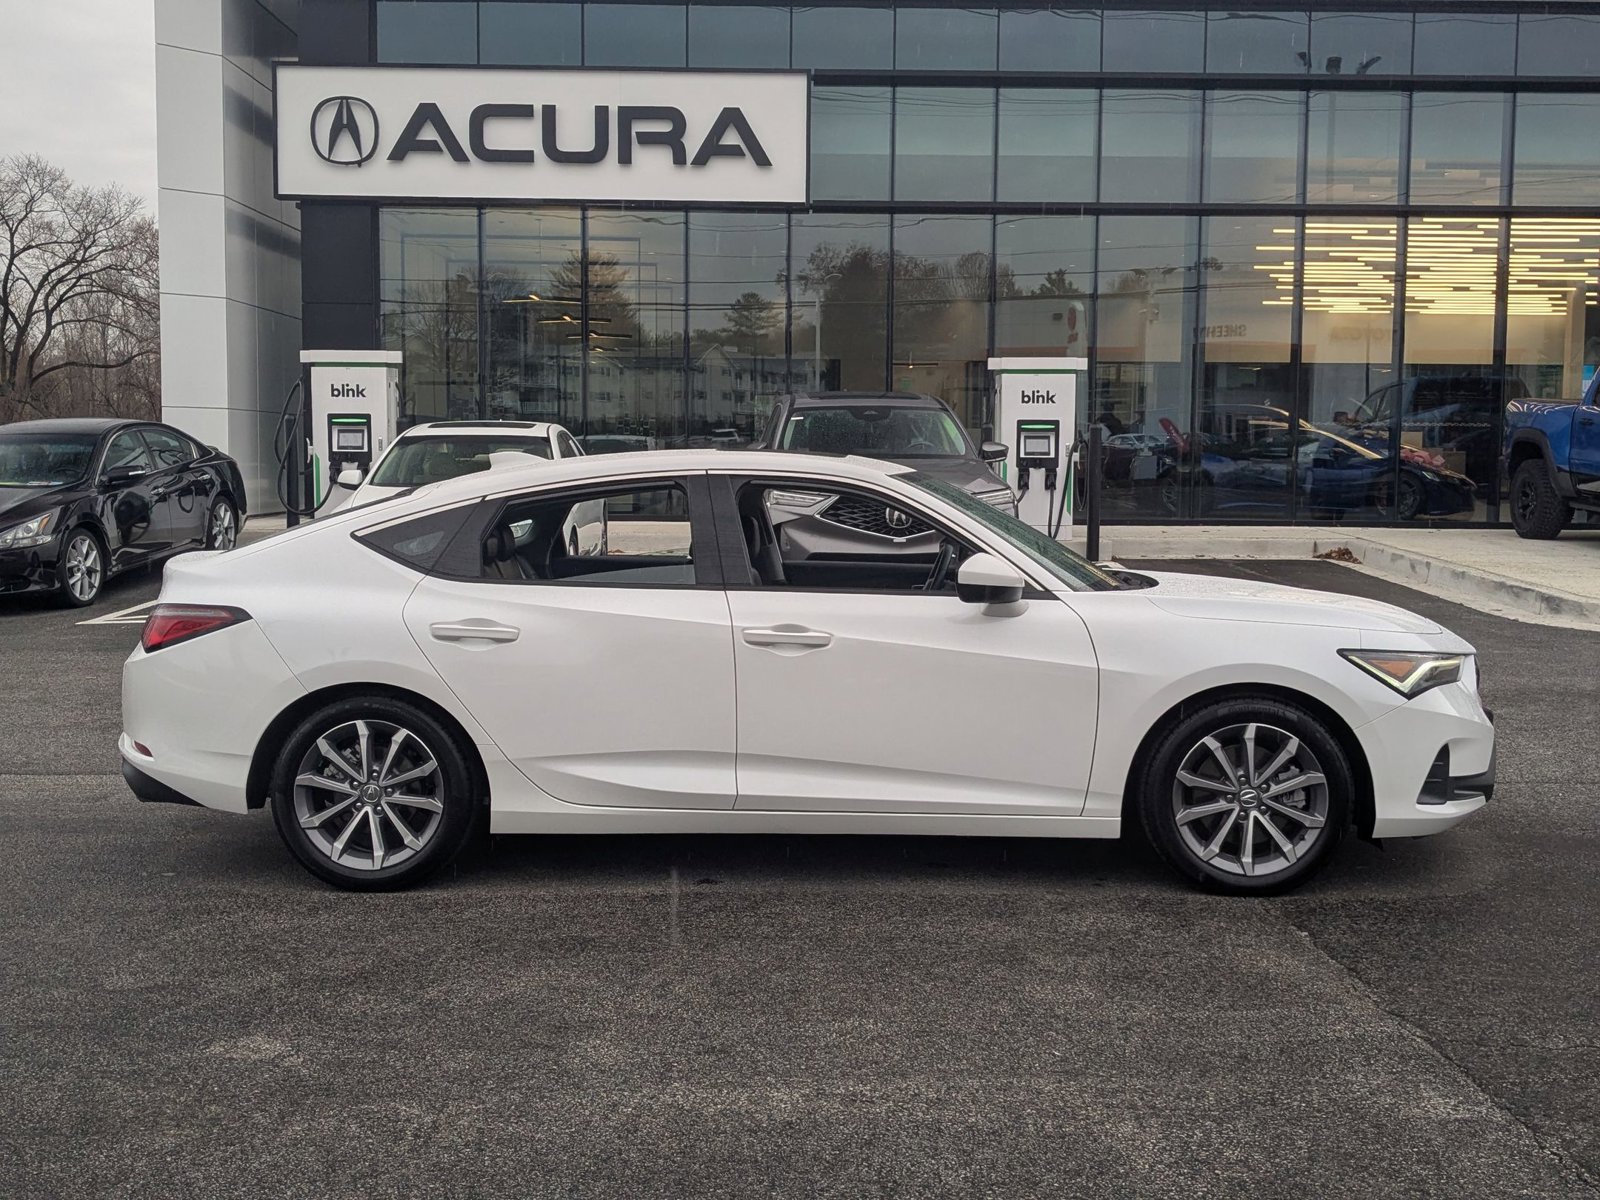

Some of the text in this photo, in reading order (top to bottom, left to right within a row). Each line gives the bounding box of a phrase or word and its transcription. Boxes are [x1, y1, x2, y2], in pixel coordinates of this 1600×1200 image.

[386, 102, 773, 167] ACURA
[331, 383, 366, 398] blink
[1021, 390, 1056, 404] blink
